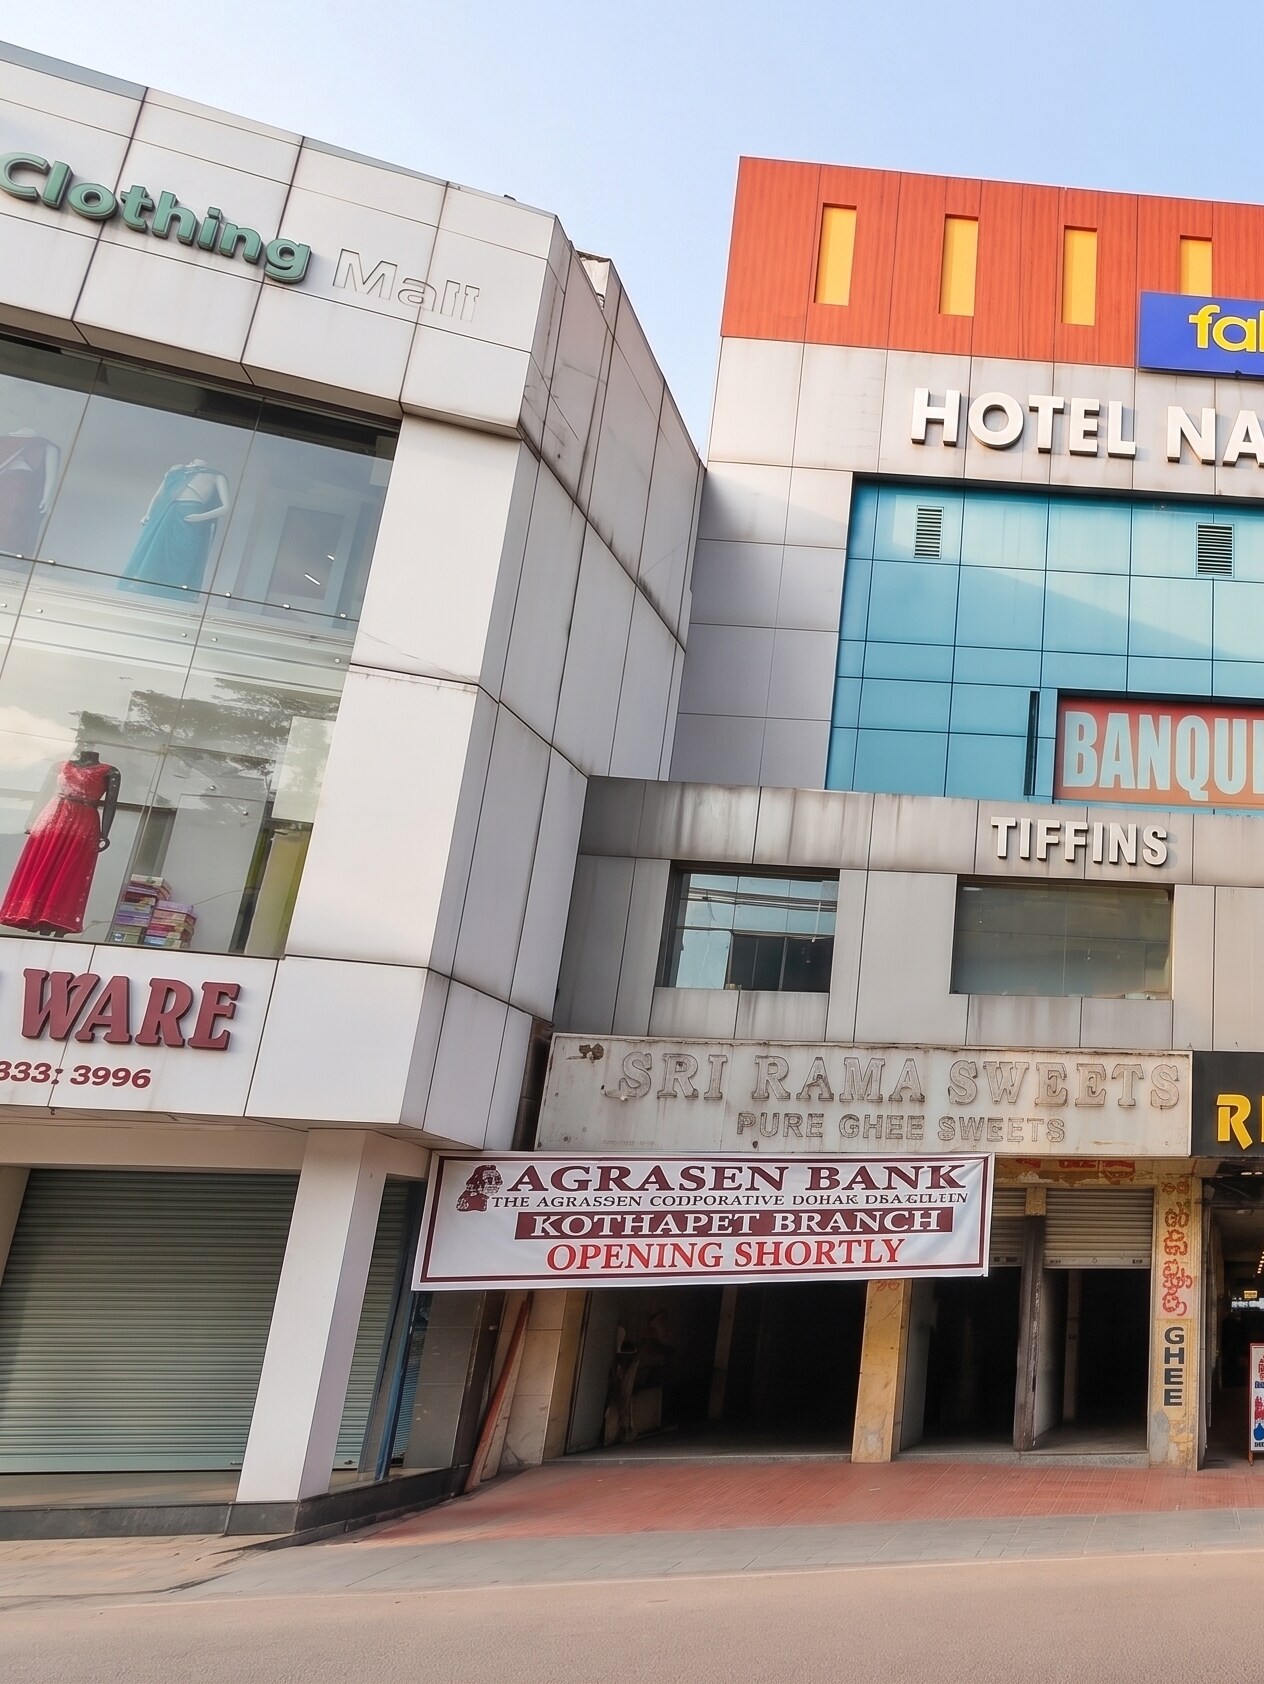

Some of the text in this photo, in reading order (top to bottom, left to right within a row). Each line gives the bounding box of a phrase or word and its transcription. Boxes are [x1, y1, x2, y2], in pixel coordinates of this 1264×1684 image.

[0, 151, 312, 284] Clothing
[910, 386, 1138, 459] HOTEL
[990, 816, 1169, 866] TIFFINS
[21, 967, 242, 1051] WARE
[69, 1064, 152, 1089] 3996
[620, 1050, 1181, 1109] SRI RAMA SWEETS
[737, 1111, 1066, 1143] PURE GHEE SWEETS
[507, 1164, 967, 1193] AGRASEN BANK
[491, 1196, 530, 1208] THE
[530, 1209, 942, 1237] KOTHAPET BRANCH
[546, 1238, 906, 1272] OPENING SHORTLY
[1163, 1325, 1185, 1408] GHEE
